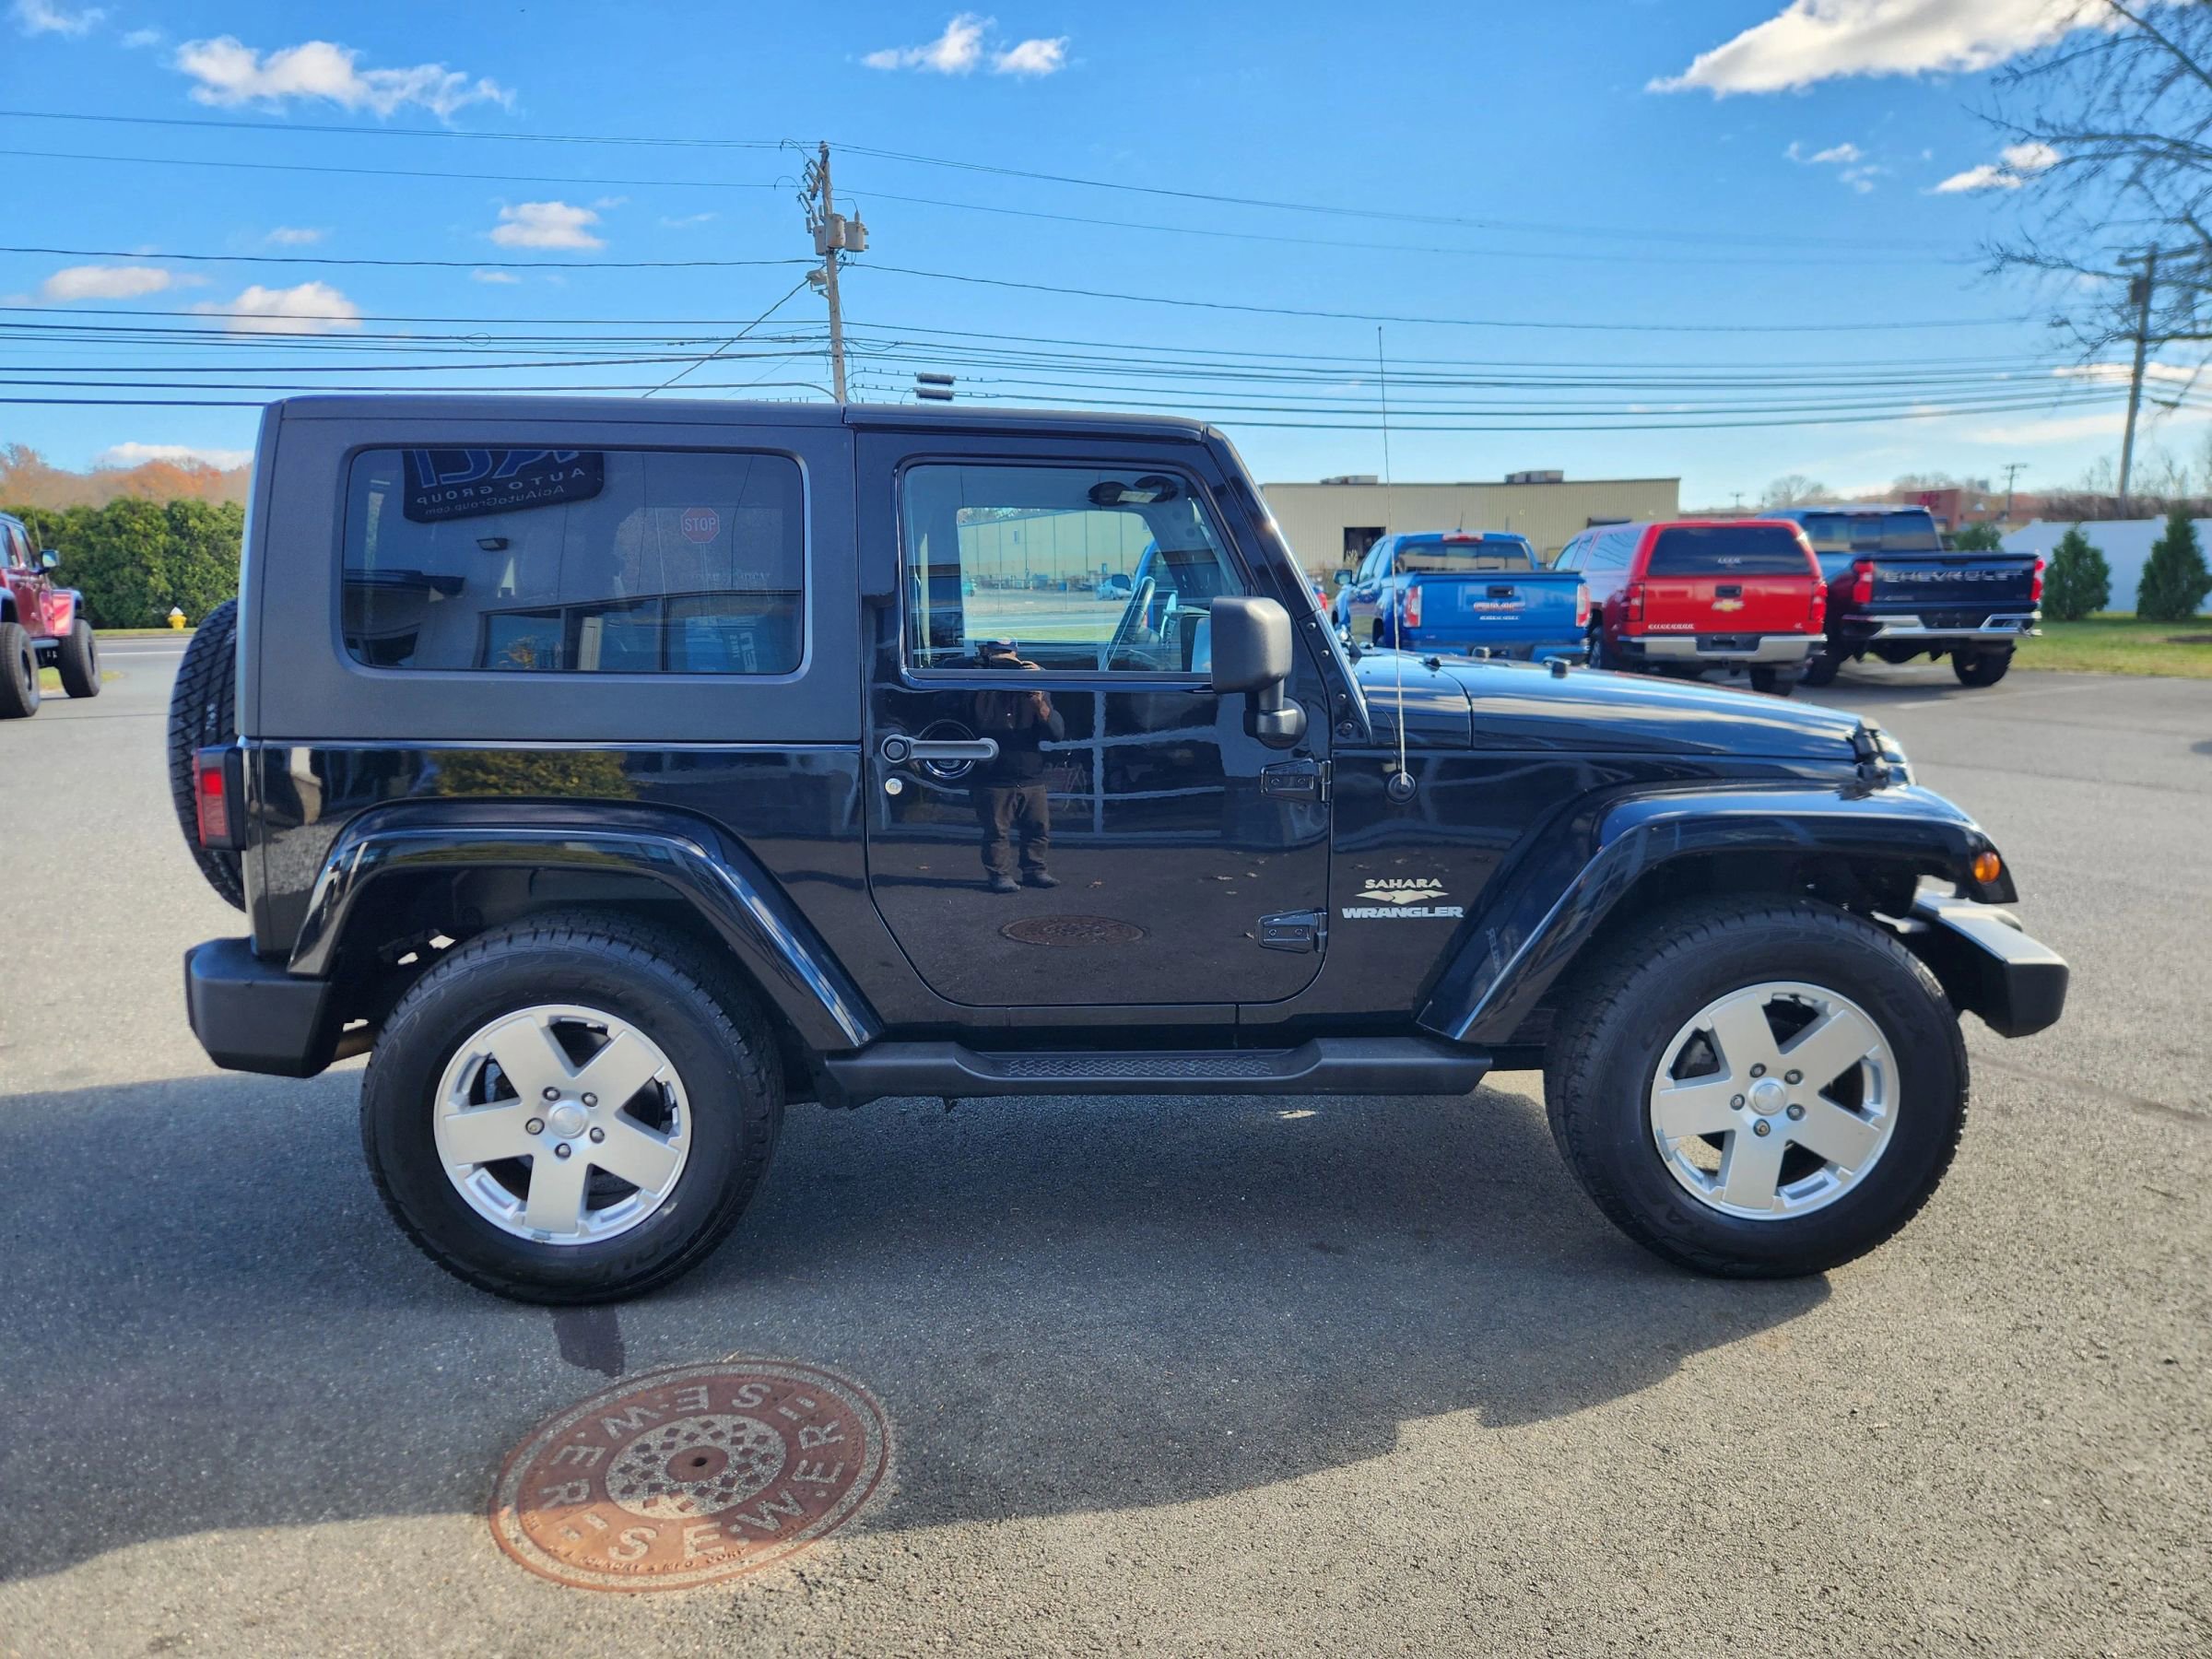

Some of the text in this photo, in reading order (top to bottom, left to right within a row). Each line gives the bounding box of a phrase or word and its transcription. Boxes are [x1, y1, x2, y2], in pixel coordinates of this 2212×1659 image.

[684, 517, 716, 531] STOP
[1883, 570, 2023, 582] CHEVROLET
[1365, 878, 1442, 888] SAHARA
[1341, 906, 1464, 918] WRANGLER
